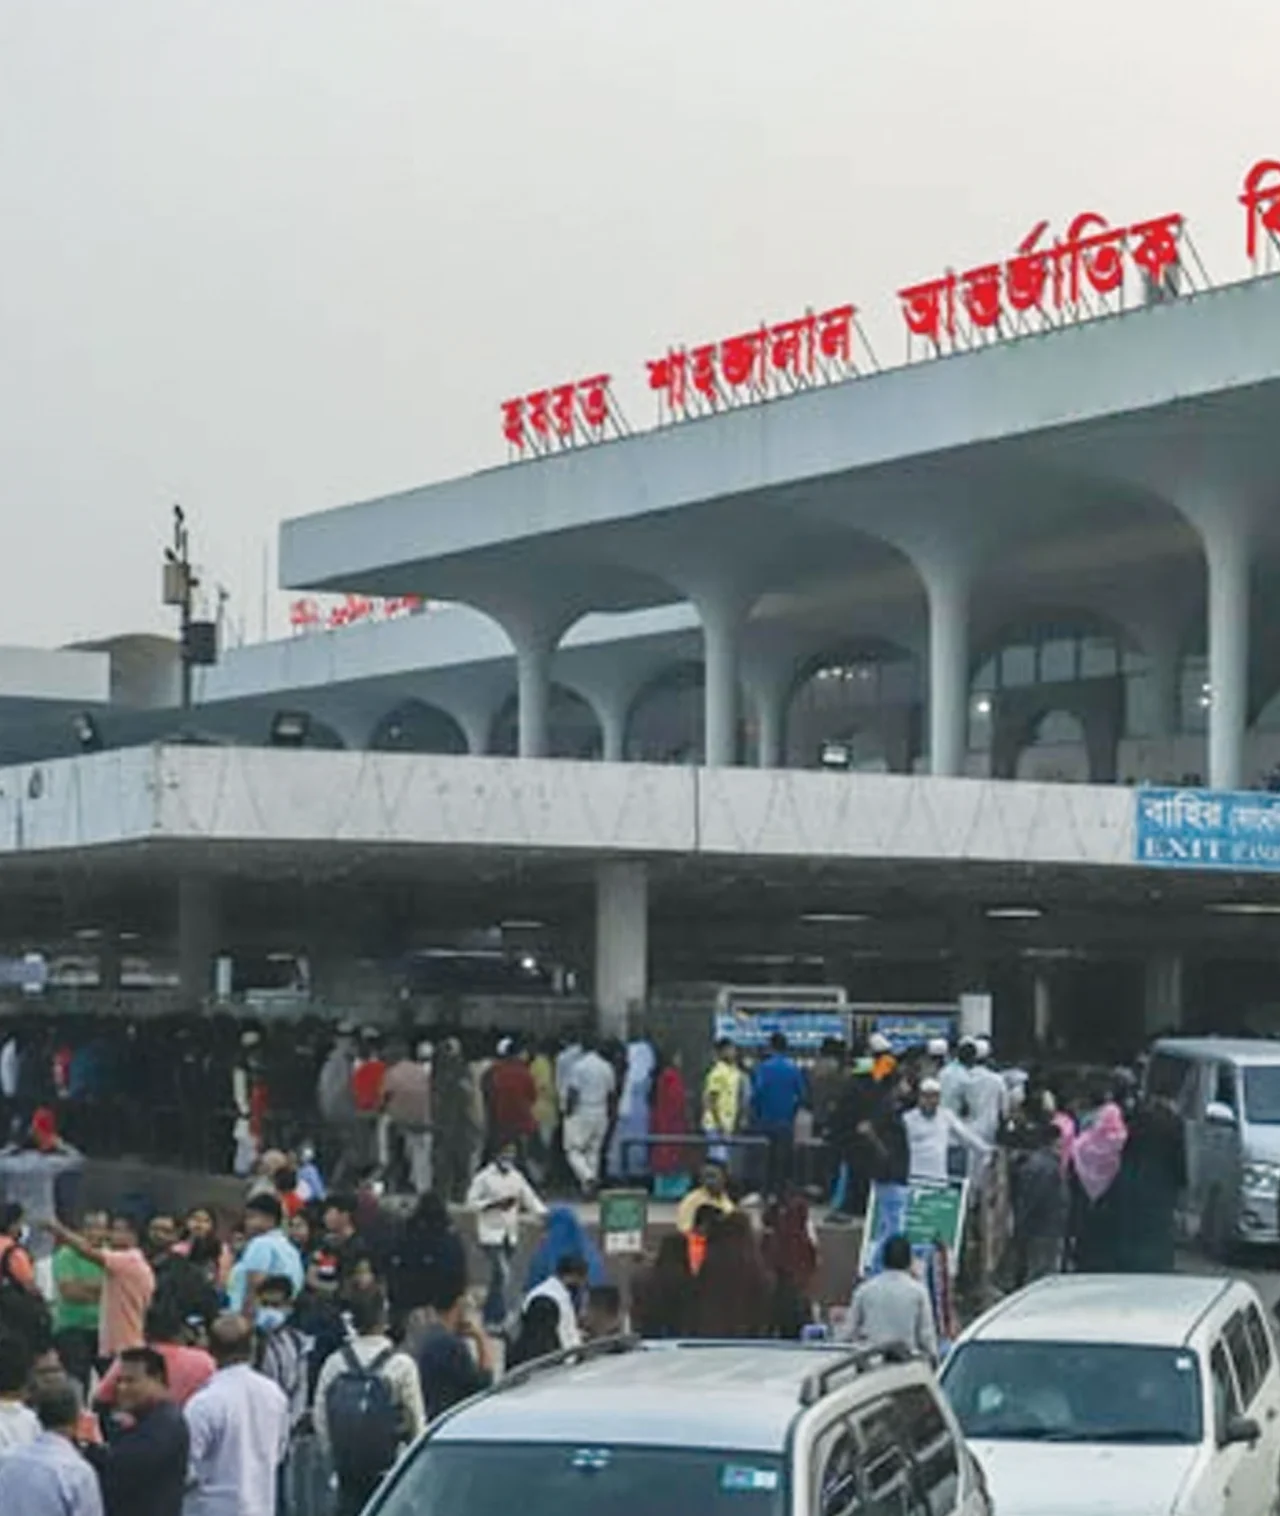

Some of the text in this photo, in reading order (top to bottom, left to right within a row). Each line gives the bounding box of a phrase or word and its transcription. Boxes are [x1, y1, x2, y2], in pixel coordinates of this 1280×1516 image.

[502, 374, 608, 448] হযরত
[647, 304, 855, 406] শাহজালাল
[899, 211, 1183, 342] আন্তর্জাতিক
[1142, 791, 1222, 830] বাহির
[1143, 837, 1222, 858] EXIT
